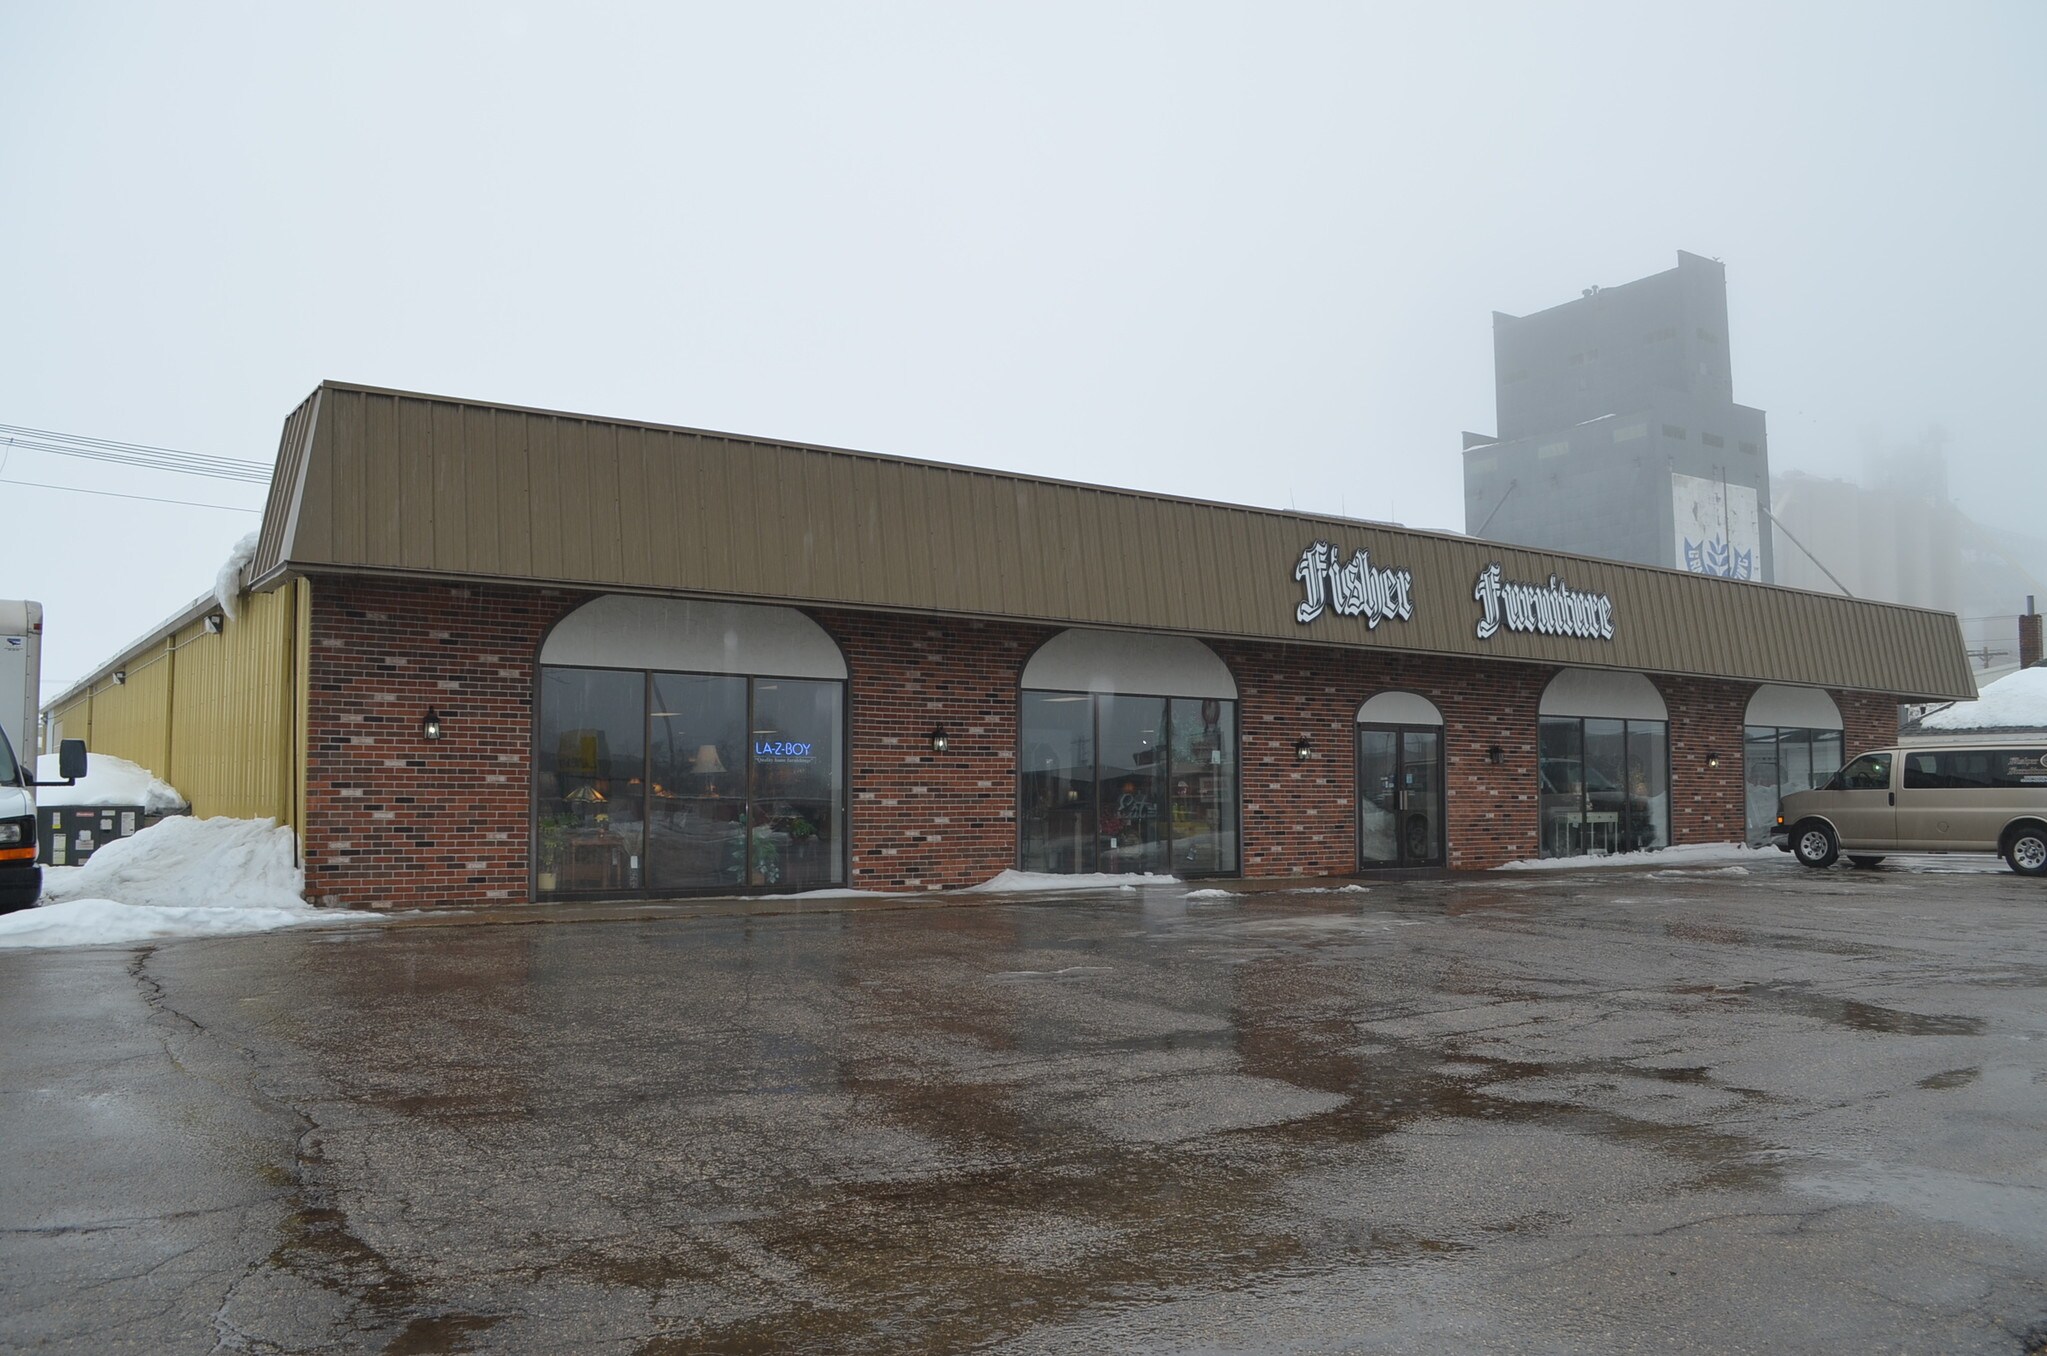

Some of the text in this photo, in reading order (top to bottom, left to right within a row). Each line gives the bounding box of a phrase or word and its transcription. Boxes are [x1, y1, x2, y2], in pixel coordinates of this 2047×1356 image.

[1295, 538, 1616, 640] Fisher Furniture
[755, 742, 811, 755] LA-Z-BOY
